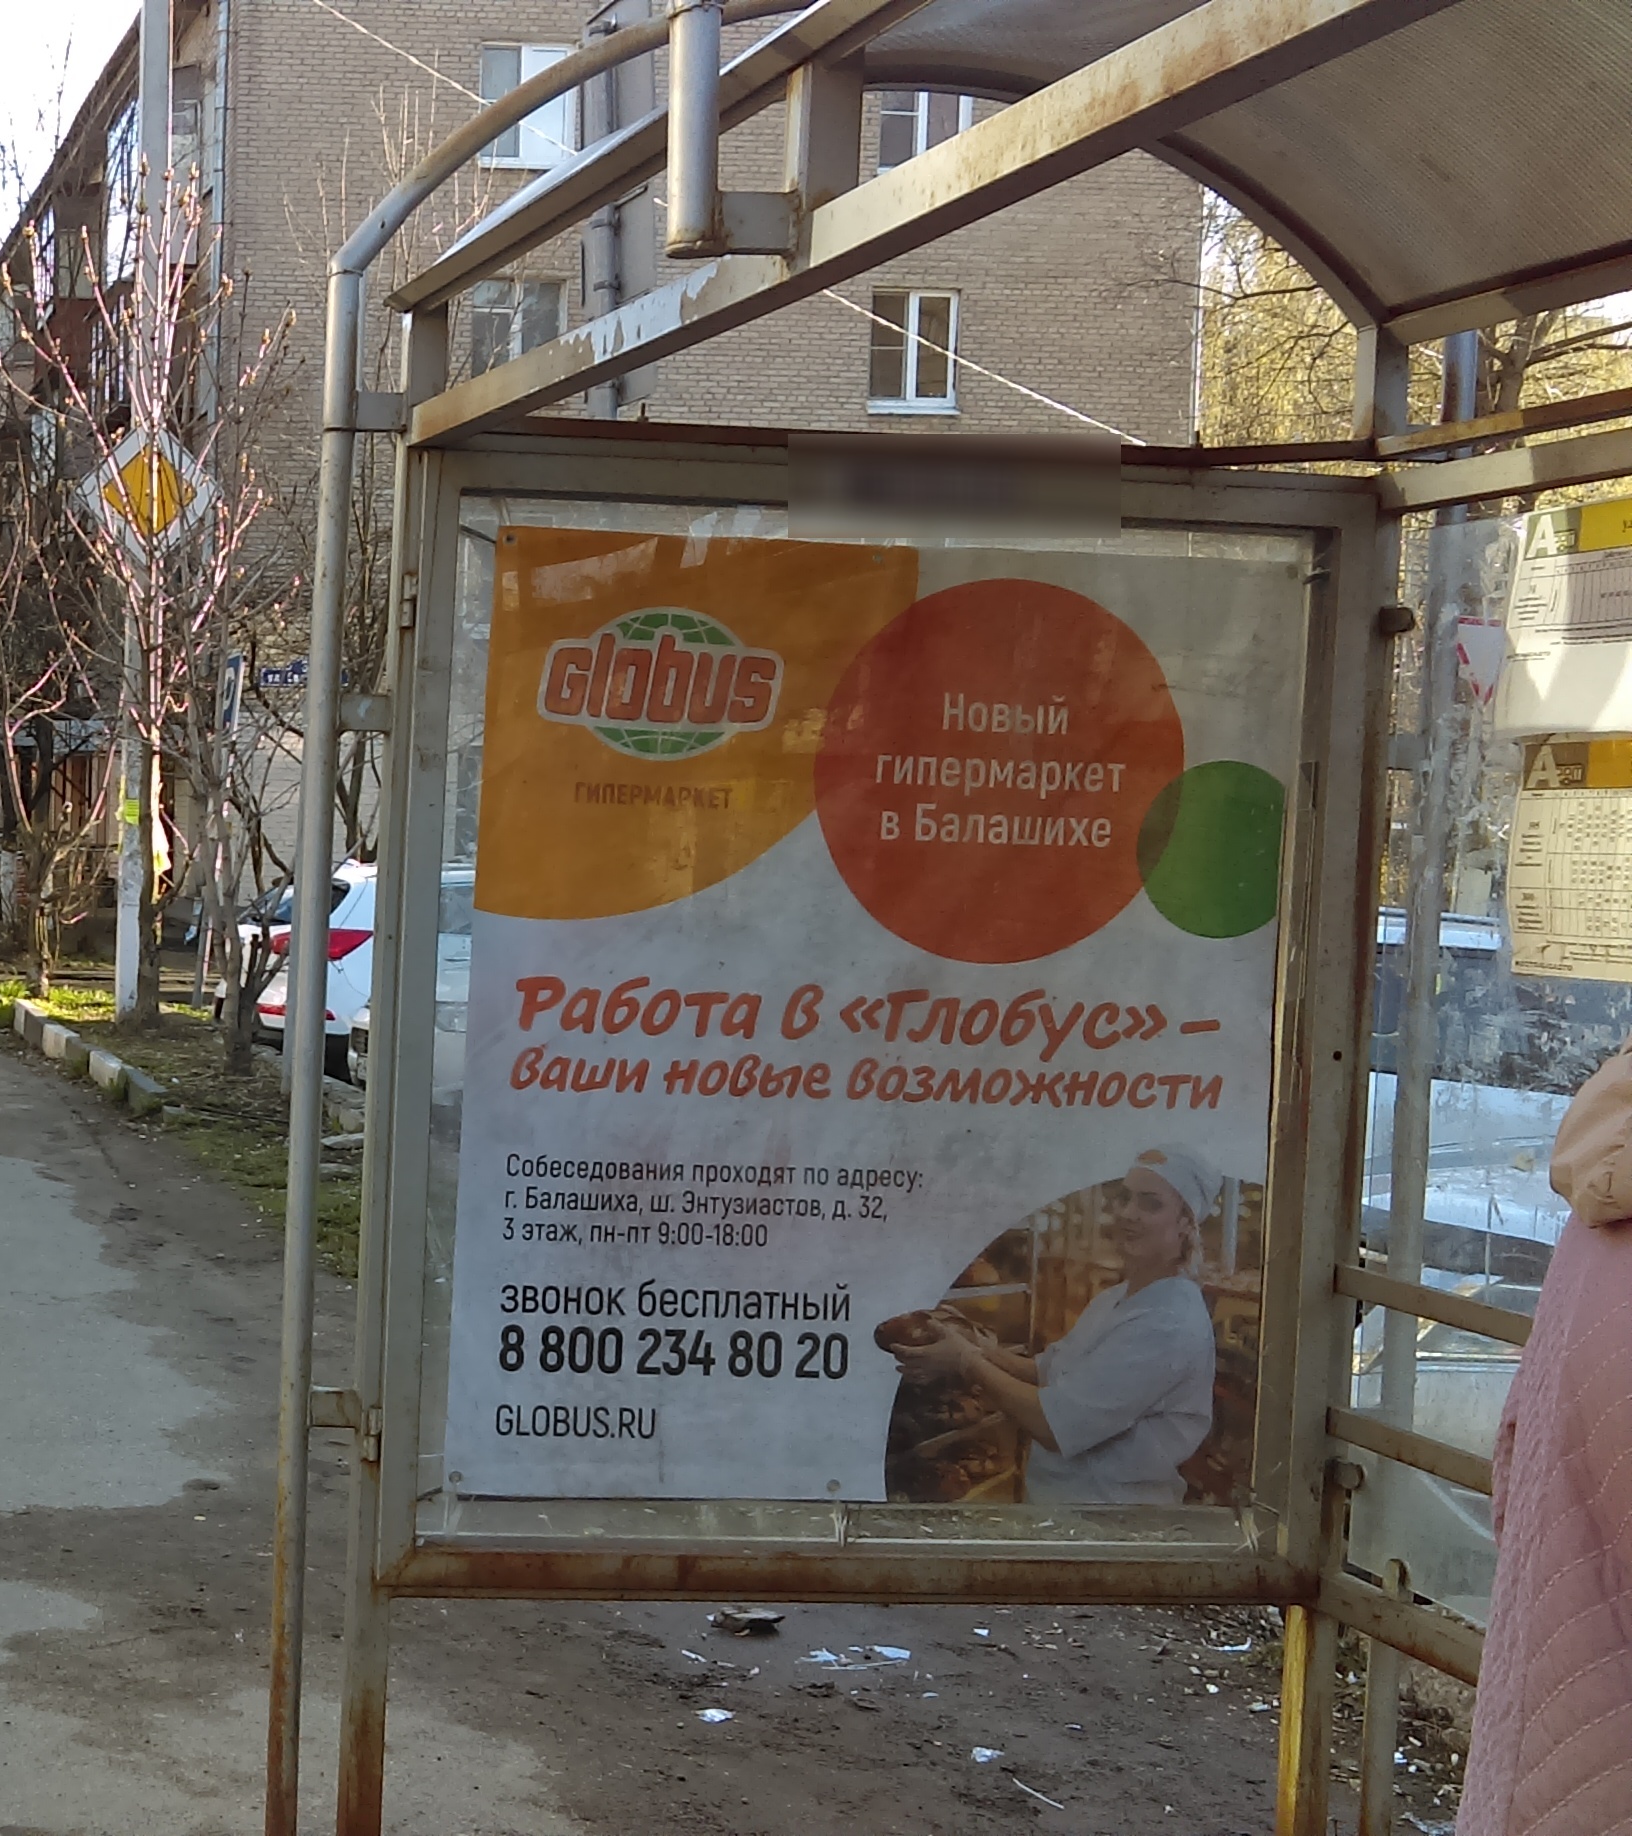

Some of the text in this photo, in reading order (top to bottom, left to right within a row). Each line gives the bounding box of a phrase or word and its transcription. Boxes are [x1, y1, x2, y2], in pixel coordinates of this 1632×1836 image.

[942, 692, 1068, 735] Новый
[572, 779, 733, 812] ГИПЕРМАРКЕТ
[875, 754, 1126, 799] гипермаркет
[880, 803, 1111, 848] в Балашихе
[516, 976, 762, 1040] Работа
[839, 988, 1168, 1062] «Глобус»
[664, 1055, 830, 1099] новые
[846, 1053, 1223, 1109] возможности
[506, 1153, 925, 1194] Собеседования проходят по адресу:
[505, 1186, 888, 1222] г. Балашиха, ш. Энтузиастов, д. 32,
[502, 1217, 768, 1247] 3 этаж, пн-пт 9:00-18:00
[638, 1278, 850, 1322] бесплатный
[499, 1324, 849, 1380] 8 800 234 80 20
[495, 1404, 656, 1440] GLOBUS.RU
